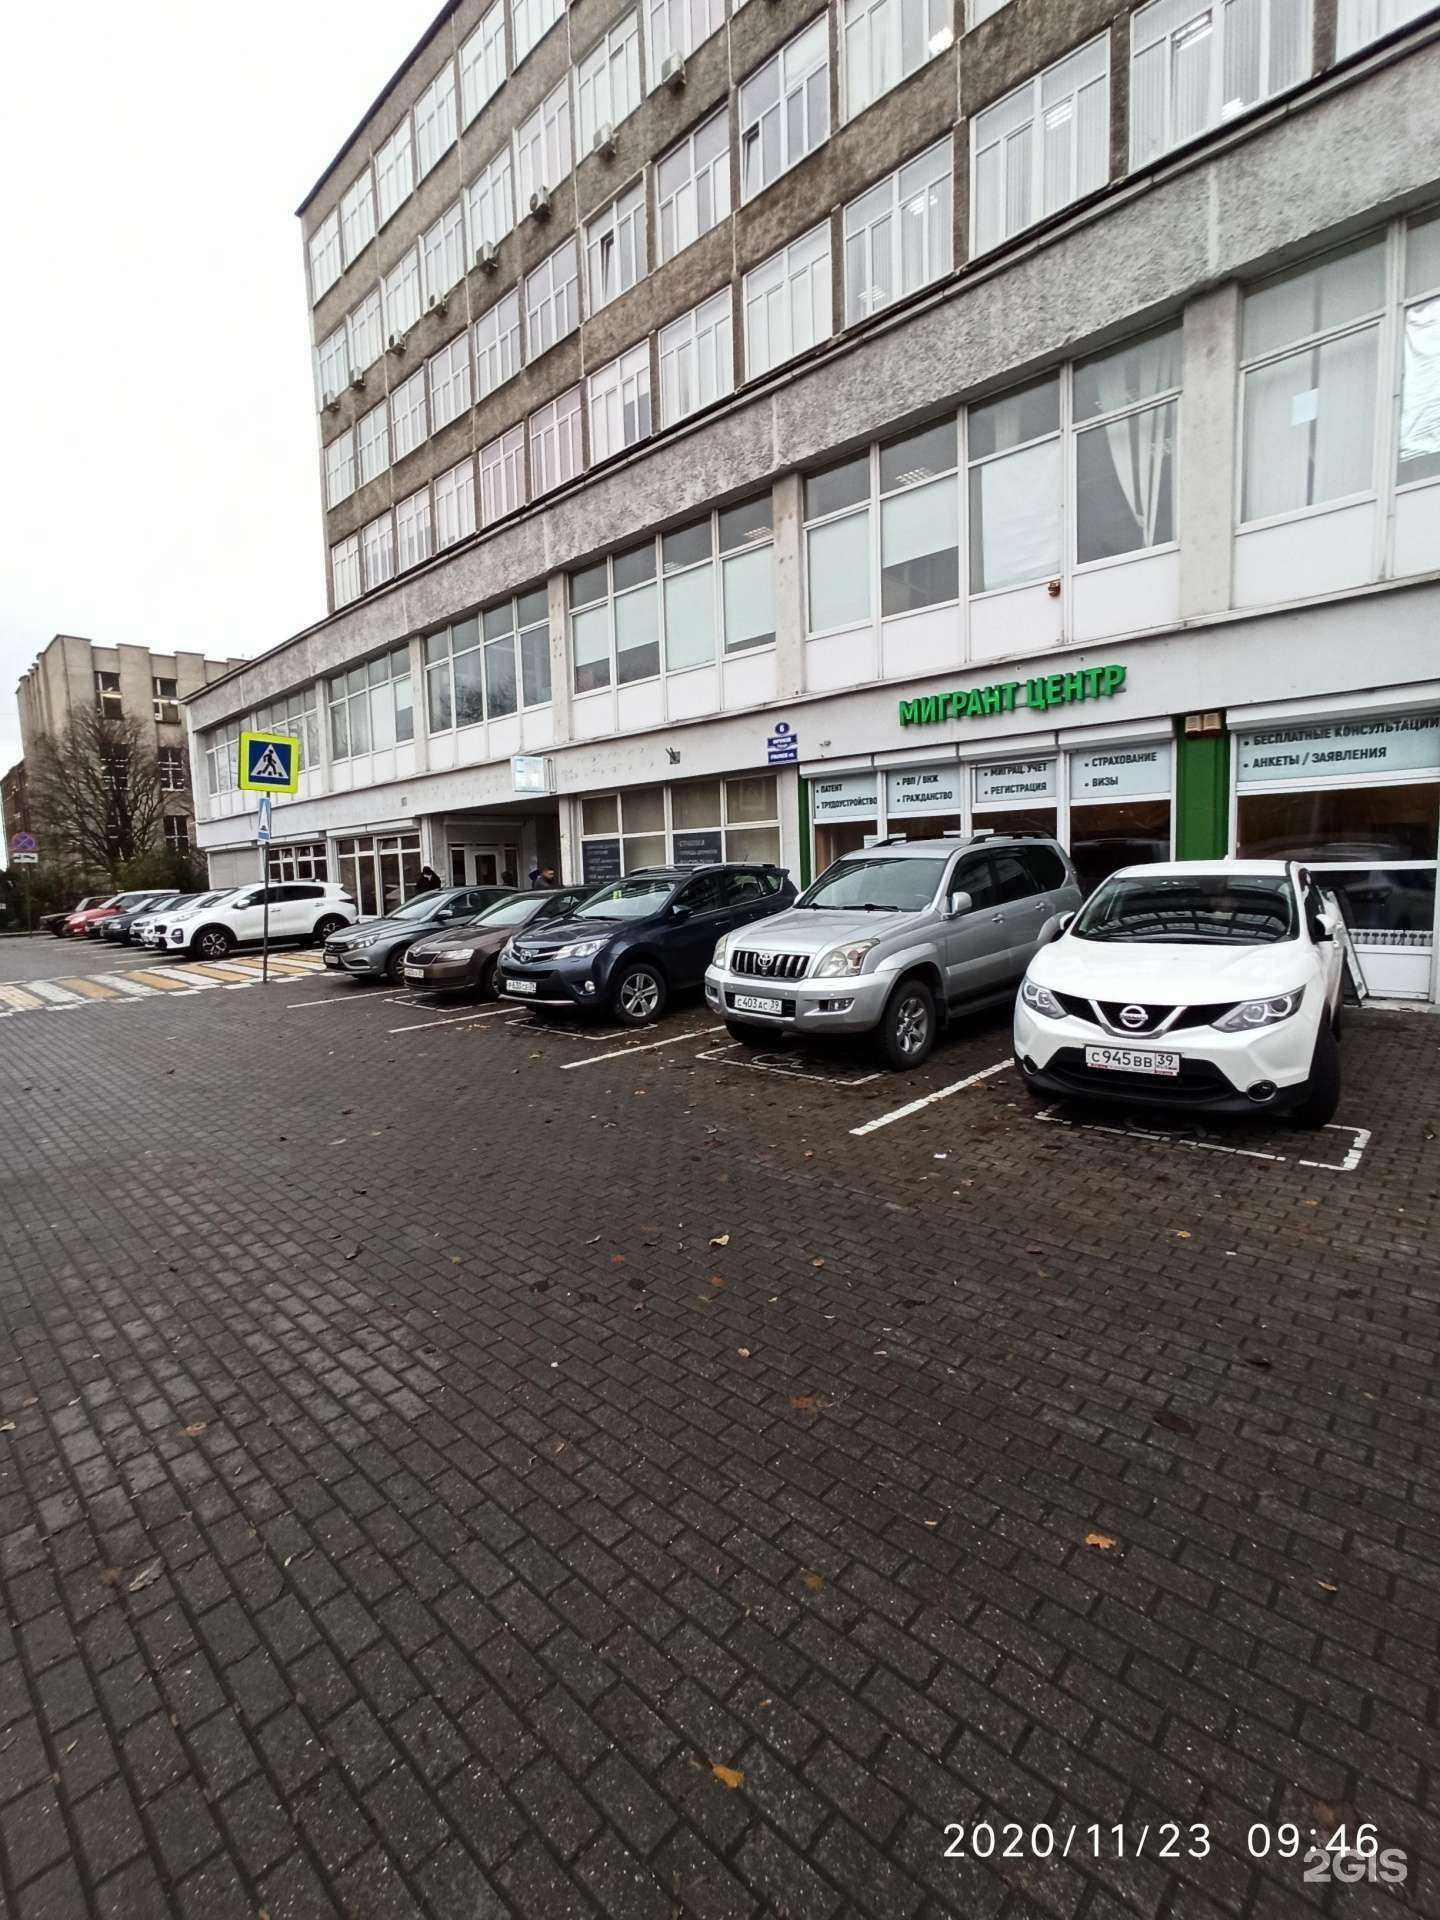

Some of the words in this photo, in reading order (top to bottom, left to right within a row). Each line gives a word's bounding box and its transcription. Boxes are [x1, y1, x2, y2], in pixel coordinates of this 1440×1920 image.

[899, 681, 1019, 726] МИГРАНТ
[1026, 664, 1127, 711] ЦЕНТР
[1253, 729, 1331, 746] БЕСПЛАТНЫЕ
[1335, 716, 1440, 737] КОНСУЛЬТАЦИИ
[1091, 752, 1157, 767] СТРАХОВАНИЕ
[1253, 754, 1300, 768] АНКЕТЫ
[1302, 753, 1310, 767] /
[1311, 747, 1388, 763] ЗАЯВЛЕНИЯ
[820, 784, 843, 793] ПАТЕНТ
[990, 782, 1047, 795] РЕГИСТРАЦИЯ
[1091, 776, 1119, 787] ВИЗЫ
[821, 797, 878, 809] ТРУДОУСТРОЙСТВО
[902, 791, 953, 803] ГРАЖДАНСТВО
[1091, 1050, 1152, 1068] С945ВВ
[1157, 1054, 1174, 1066] 39
